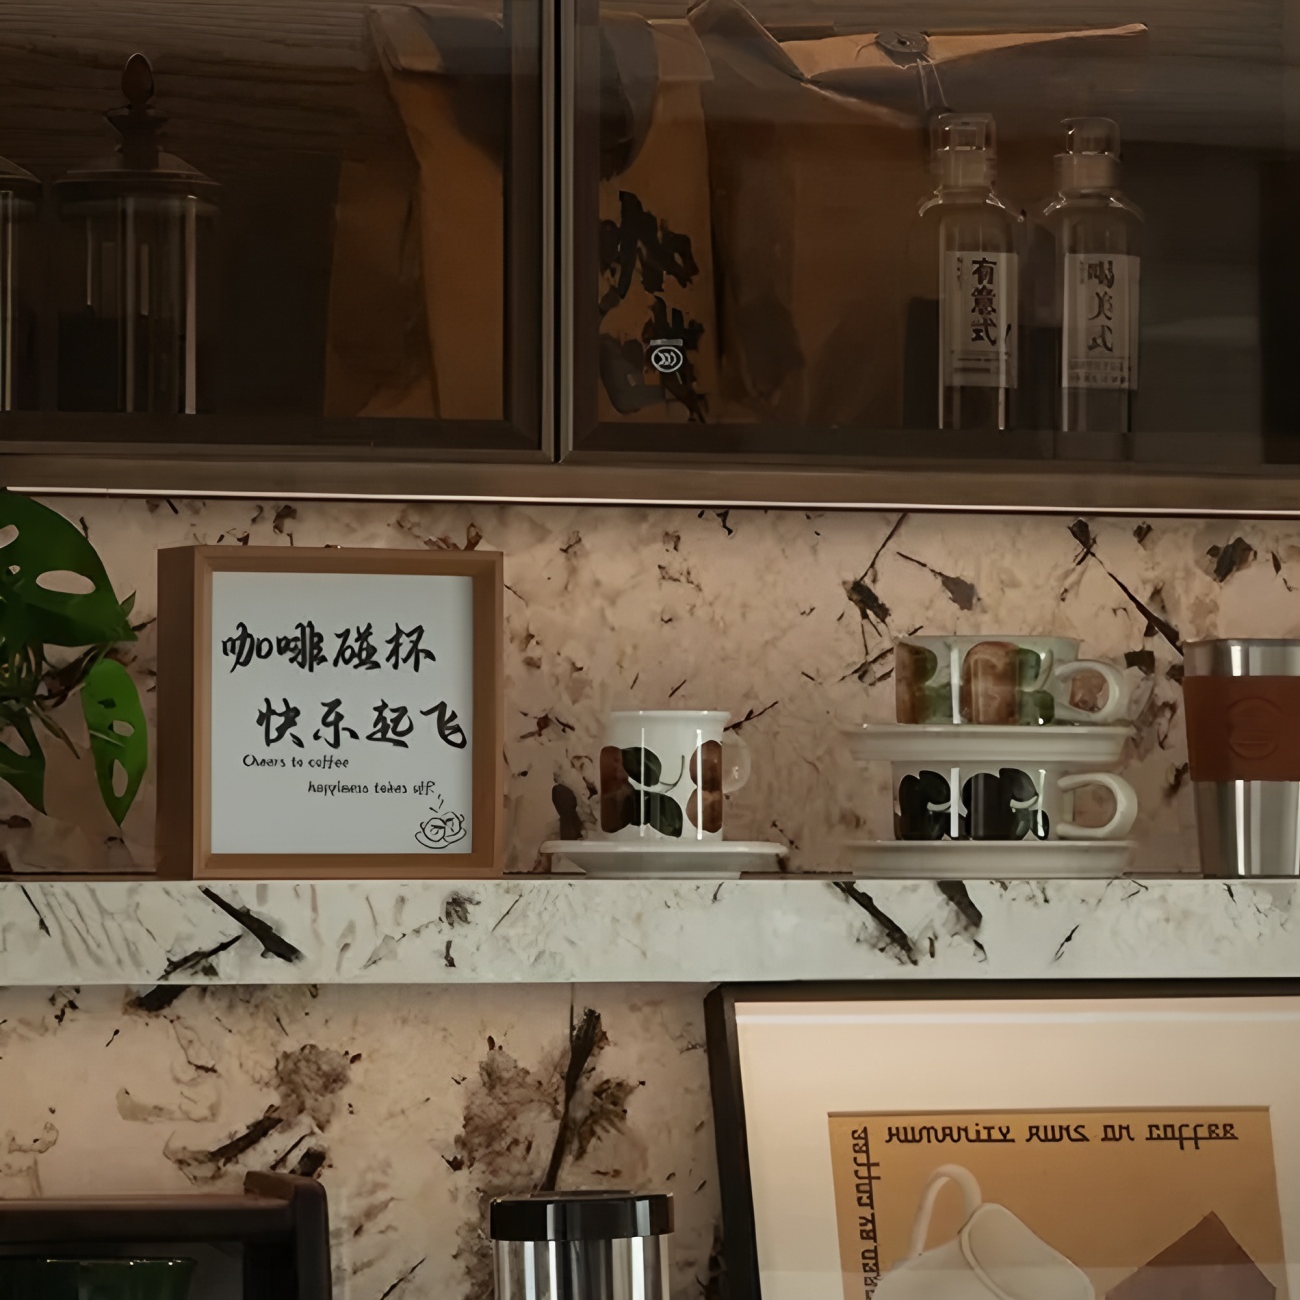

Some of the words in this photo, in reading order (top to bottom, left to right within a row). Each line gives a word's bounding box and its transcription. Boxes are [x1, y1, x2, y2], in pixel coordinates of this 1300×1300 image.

[221, 620, 436, 673] 咖啡碰杯
[255, 697, 468, 749] 快乐起飞
[291, 756, 303, 768] to
[1025, 1124, 1090, 1142] RUNS
[1100, 1124, 1135, 1142] ON
[1145, 1123, 1239, 1150] COFFEE
